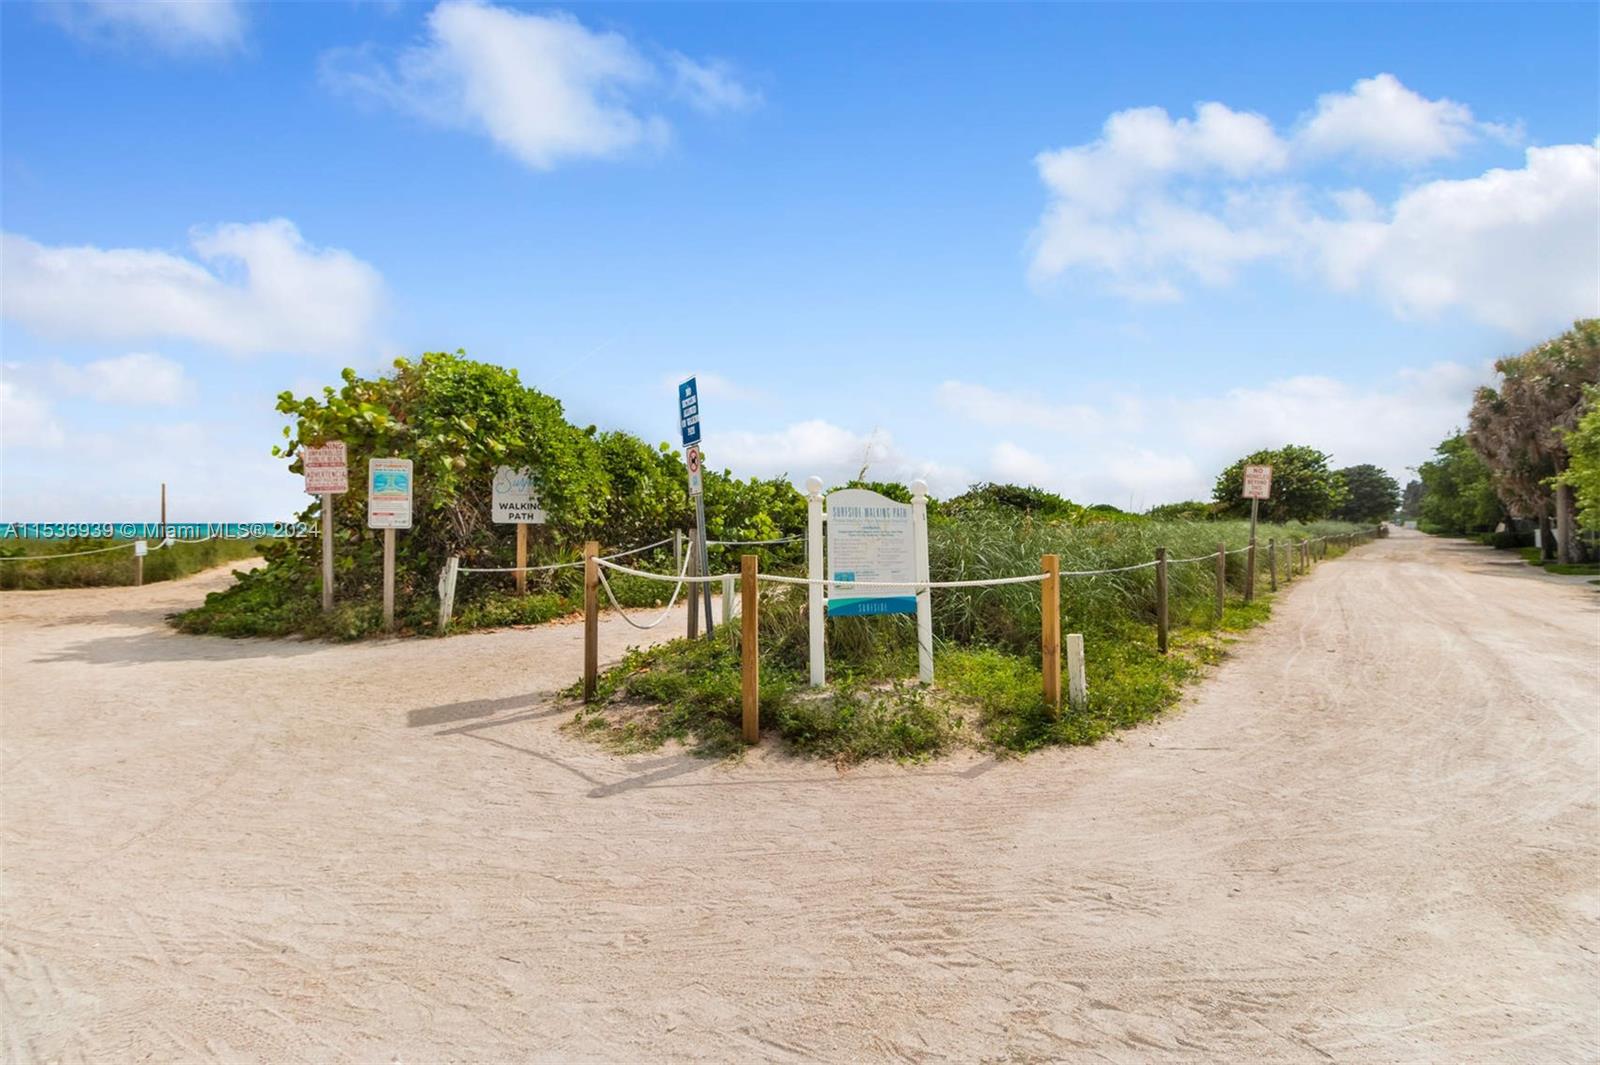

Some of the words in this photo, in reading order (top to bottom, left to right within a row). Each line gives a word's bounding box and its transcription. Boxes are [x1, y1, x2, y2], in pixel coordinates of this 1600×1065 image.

[508, 512, 534, 520] PATH
[832, 506, 862, 517] SURFSIDE
[864, 507, 890, 518] WALKING
[893, 507, 907, 518] PATH
[858, 602, 888, 613] SURFSIDE
